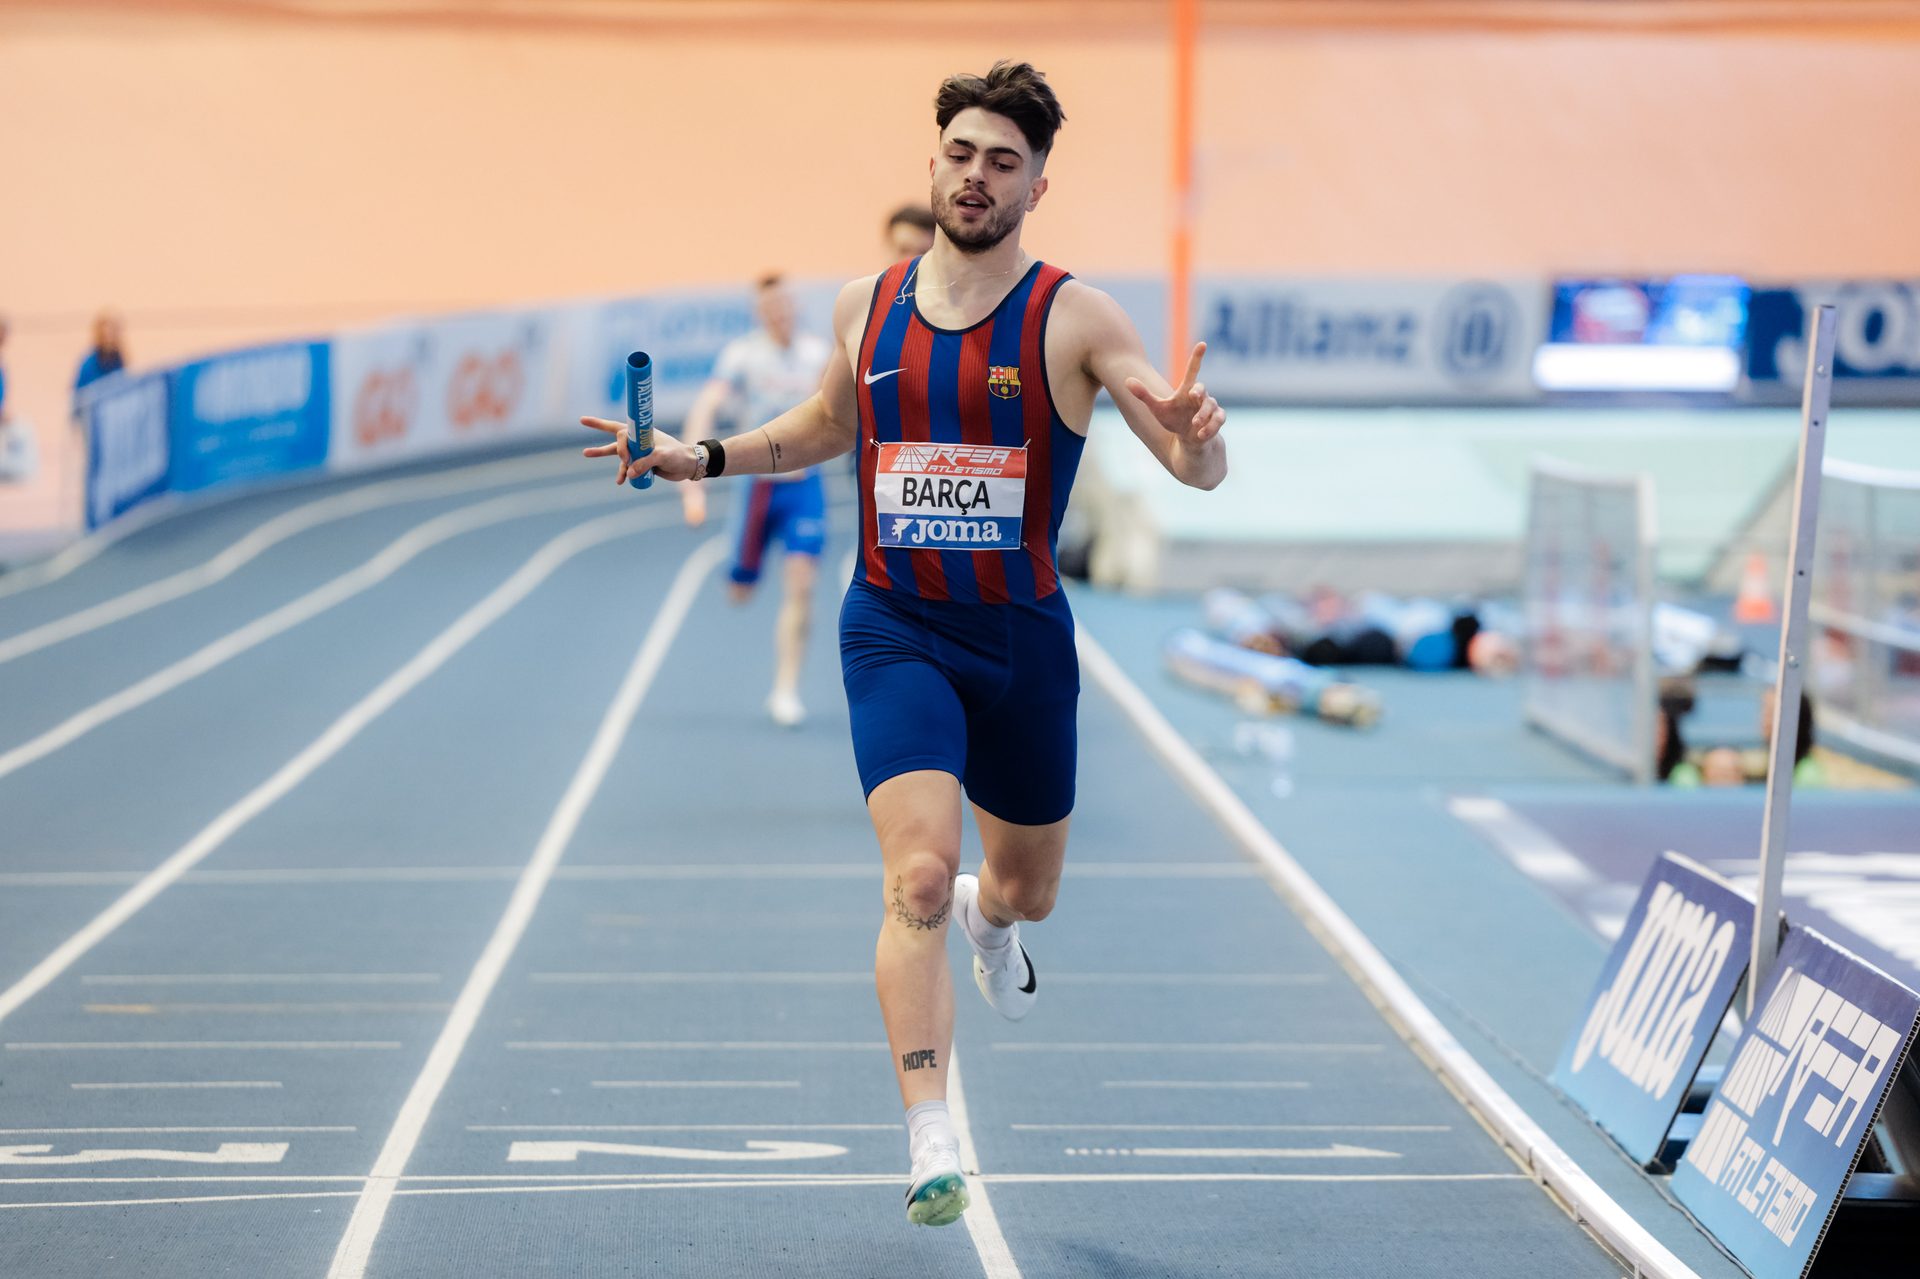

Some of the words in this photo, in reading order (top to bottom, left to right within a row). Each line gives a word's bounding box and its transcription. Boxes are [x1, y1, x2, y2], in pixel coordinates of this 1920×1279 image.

[638, 376, 653, 427] VALENCIA
[927, 465, 1003, 476] ATLETISMO
[933, 446, 1012, 466] RFEA
[902, 477, 991, 516] BARÇA
[902, 1049, 937, 1072] HOPE
[1721, 1136, 1818, 1248] ATLETISMO
